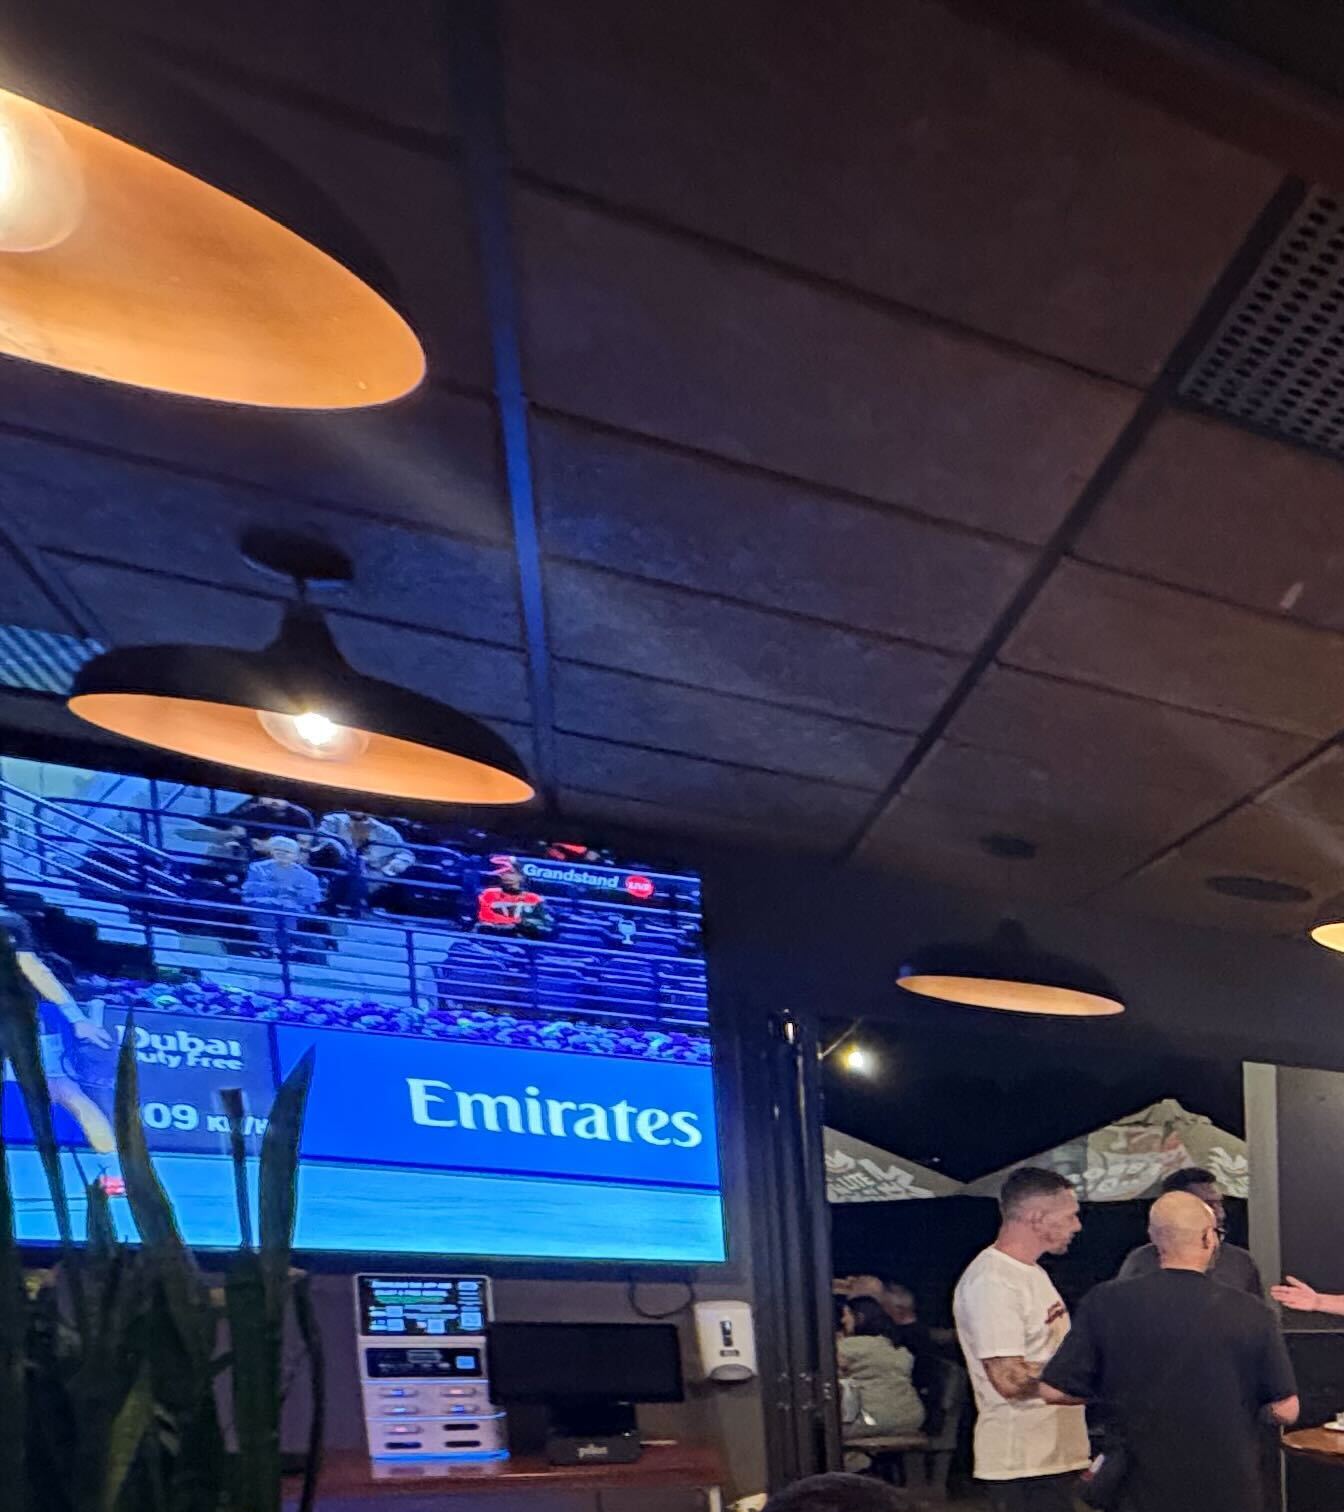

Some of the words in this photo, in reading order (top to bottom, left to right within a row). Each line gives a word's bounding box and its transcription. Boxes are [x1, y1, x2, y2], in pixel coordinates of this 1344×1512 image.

[524, 863, 620, 889] Grandstand
[115, 1025, 242, 1057] Dubai
[137, 1050, 182, 1068] uty
[187, 1052, 244, 1071] Free
[143, 1102, 199, 1131] 09
[405, 1077, 703, 1148] Emirates
